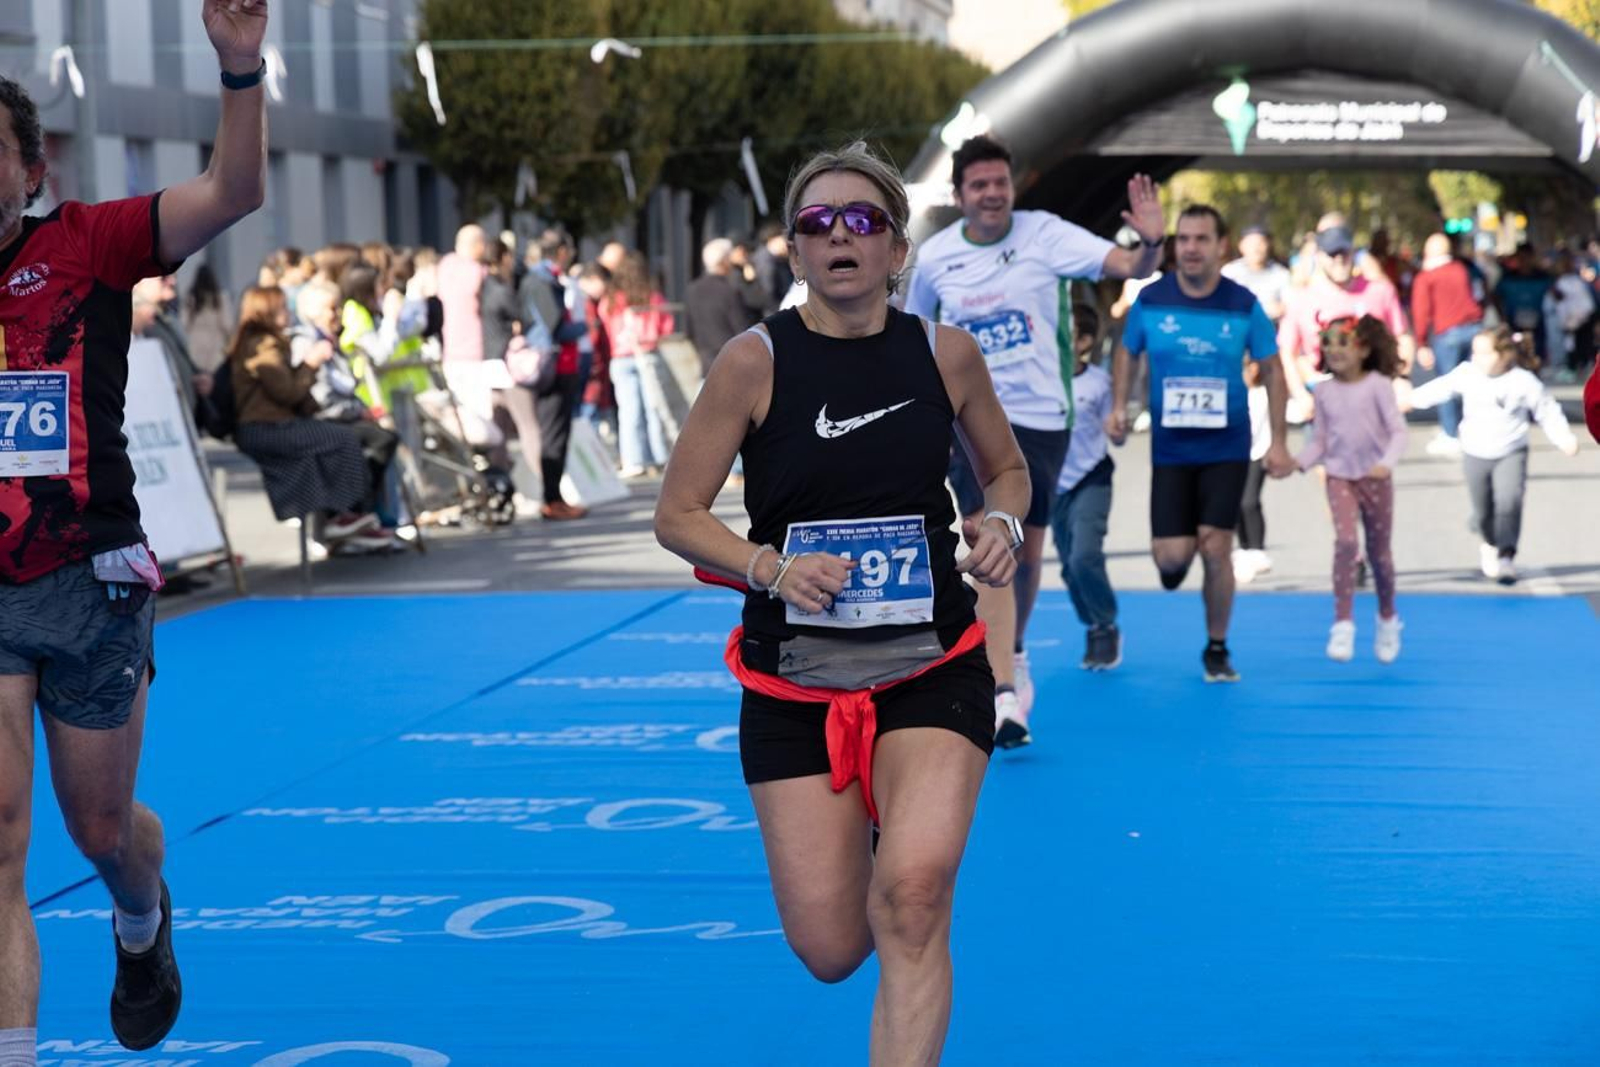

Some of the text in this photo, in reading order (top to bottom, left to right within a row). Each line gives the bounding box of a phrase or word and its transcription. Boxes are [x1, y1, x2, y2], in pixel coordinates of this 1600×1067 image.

[1339, 101, 1421, 122] Municipal
[1422, 101, 1447, 122] de
[1335, 121, 1359, 139] de
[9, 279, 47, 296] Martos
[1177, 393, 1214, 410] 712
[800, 547, 918, 588] 197
[837, 588, 884, 599] MERCEDES
